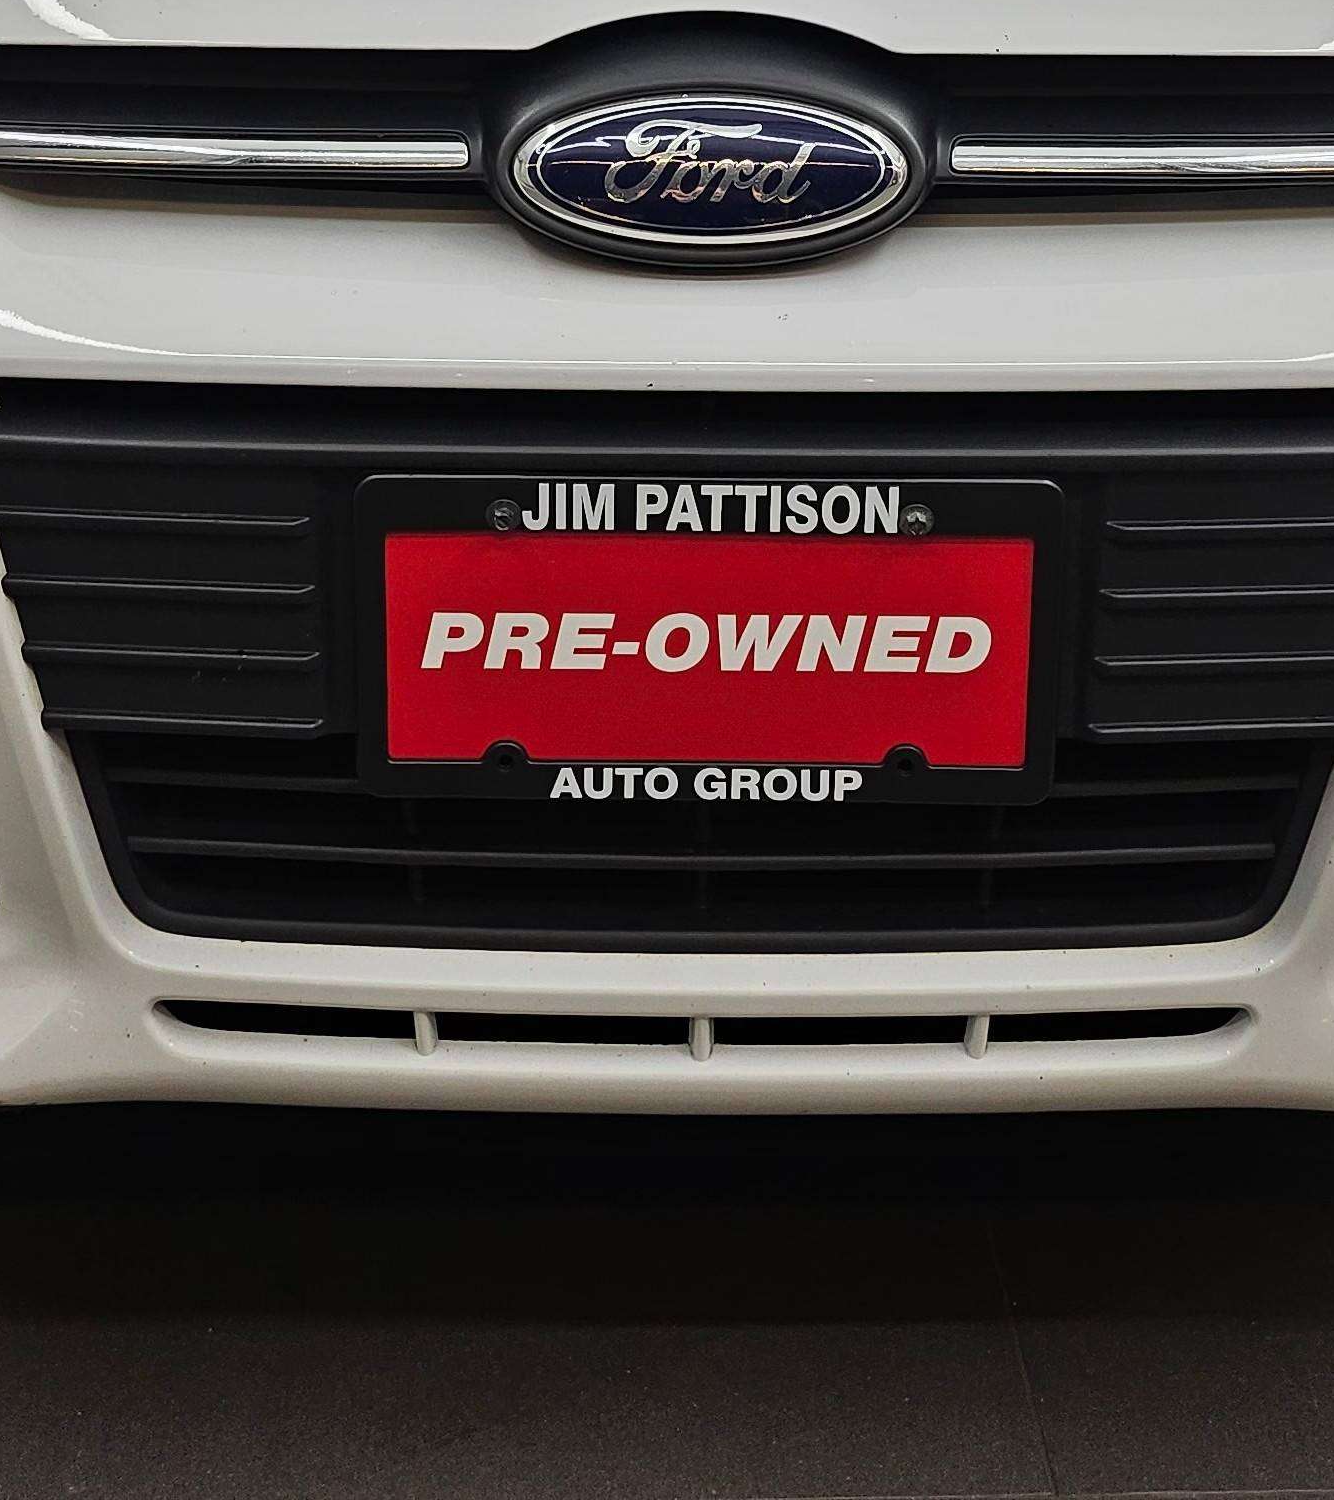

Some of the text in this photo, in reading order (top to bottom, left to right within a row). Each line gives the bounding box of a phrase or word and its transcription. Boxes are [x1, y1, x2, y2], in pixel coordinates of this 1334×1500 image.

[604, 118, 811, 204] Ford
[521, 482, 902, 535] JIM PATTISON
[420, 611, 993, 674] PRE-OWNED
[549, 766, 863, 803] AUTO GROUP
